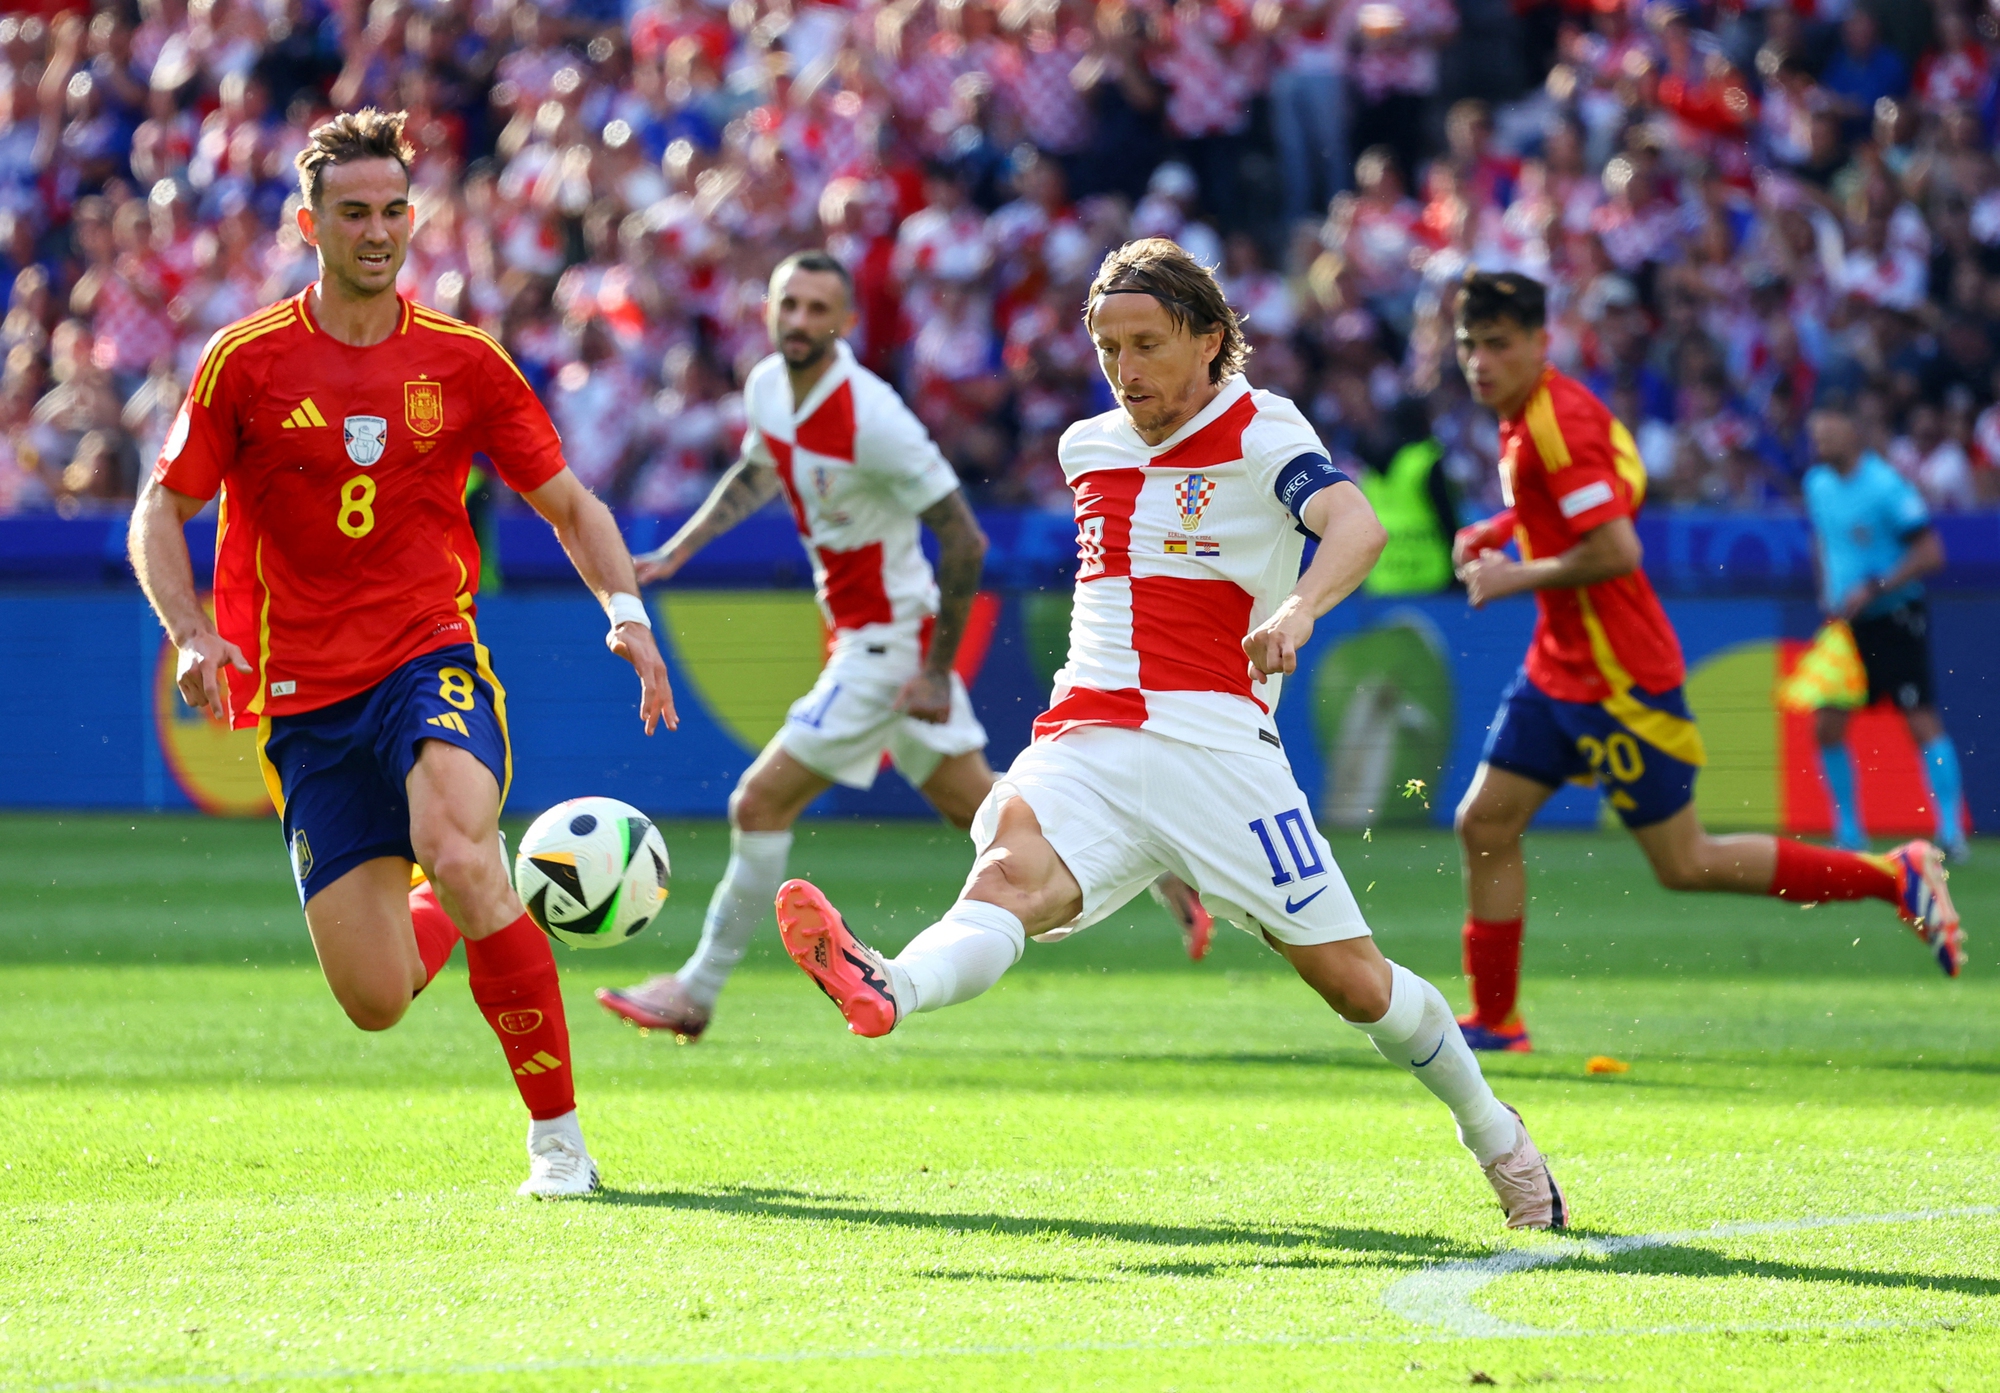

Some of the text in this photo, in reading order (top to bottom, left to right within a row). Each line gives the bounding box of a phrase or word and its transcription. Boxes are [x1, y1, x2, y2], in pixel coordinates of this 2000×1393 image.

[337, 474, 377, 539] 8
[438, 667, 475, 711] 8
[1249, 808, 1327, 887] 10
